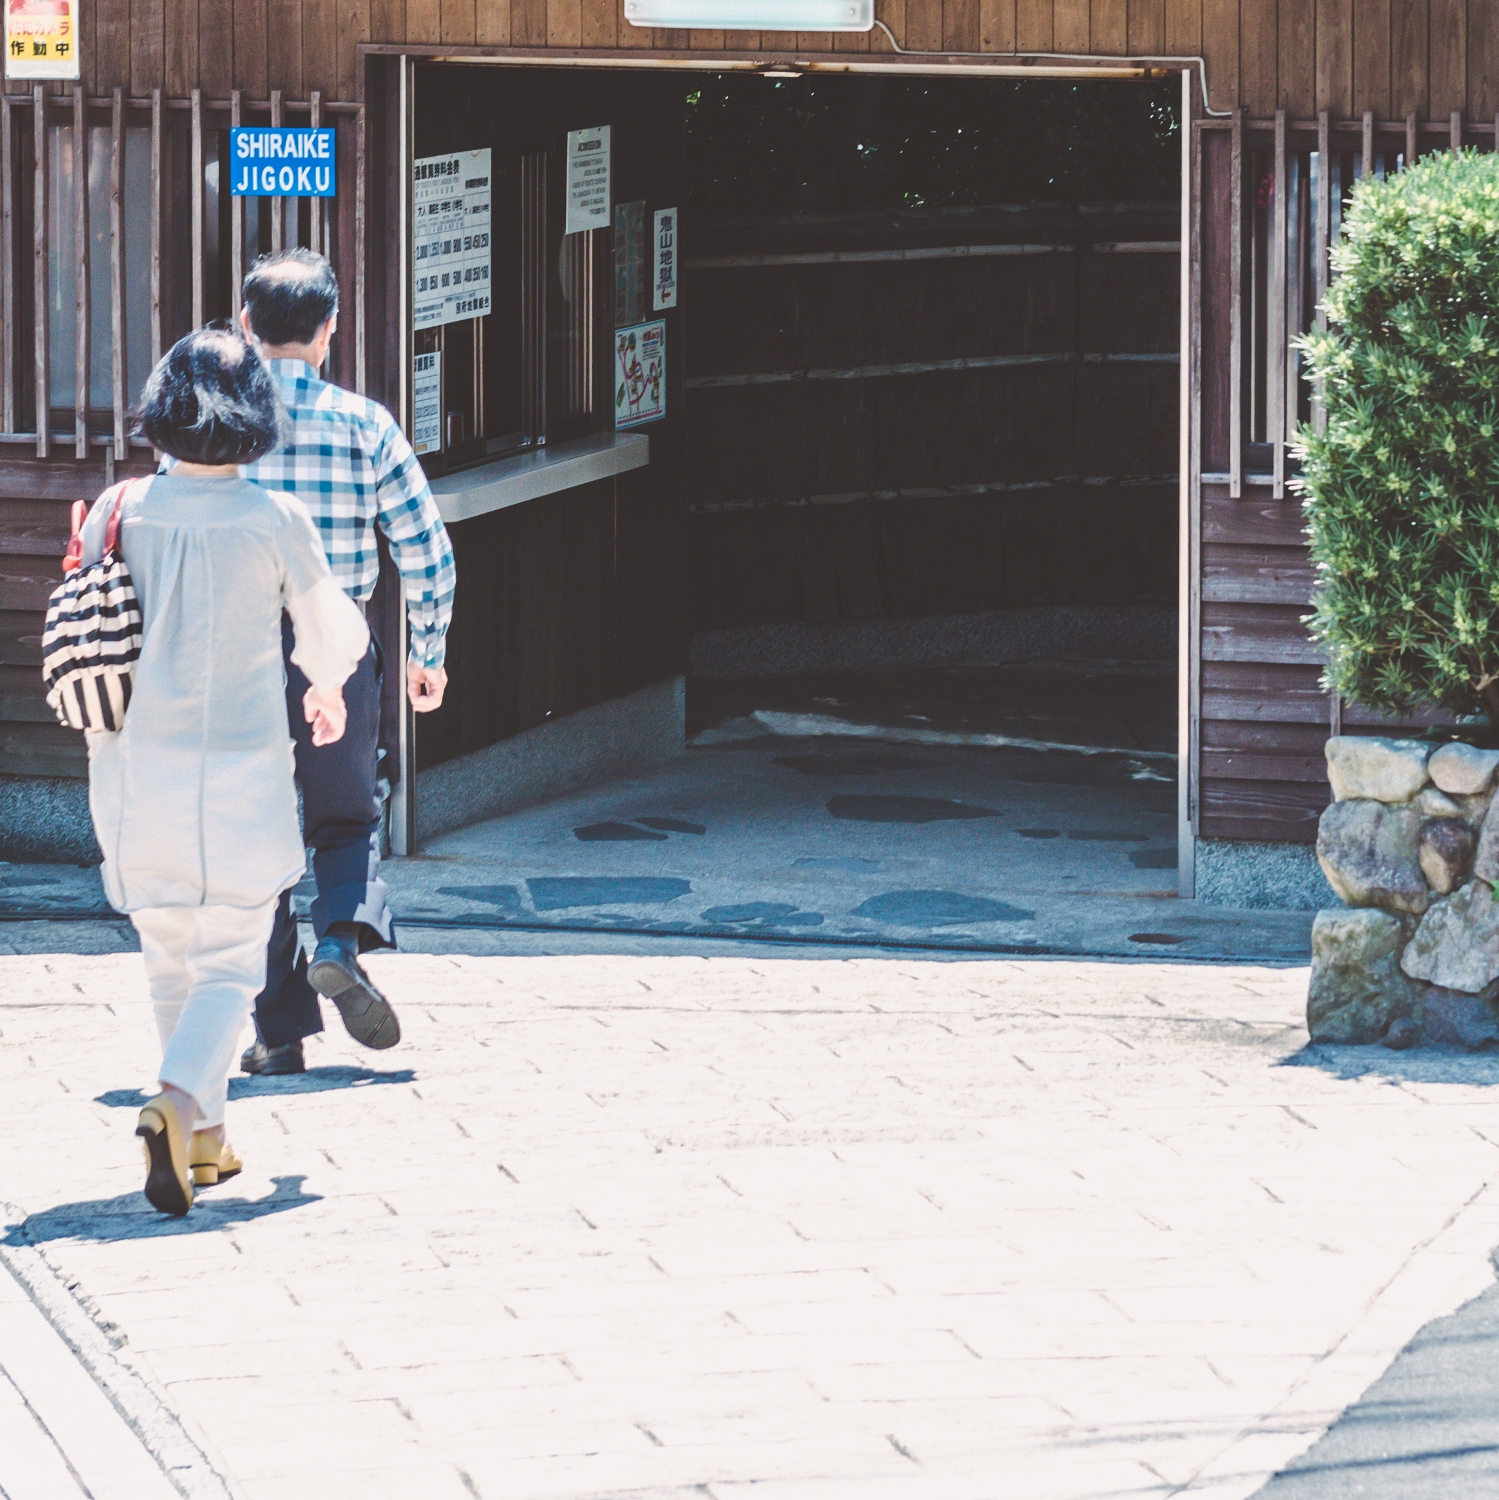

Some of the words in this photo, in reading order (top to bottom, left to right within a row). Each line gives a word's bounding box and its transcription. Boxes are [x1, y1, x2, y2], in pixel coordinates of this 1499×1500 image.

[10, 40, 70, 57] 作動中
[236, 132, 330, 160] SHIRAIKE
[237, 165, 331, 193] JIGOKU
[659, 214, 673, 284] 鬼山地獄
